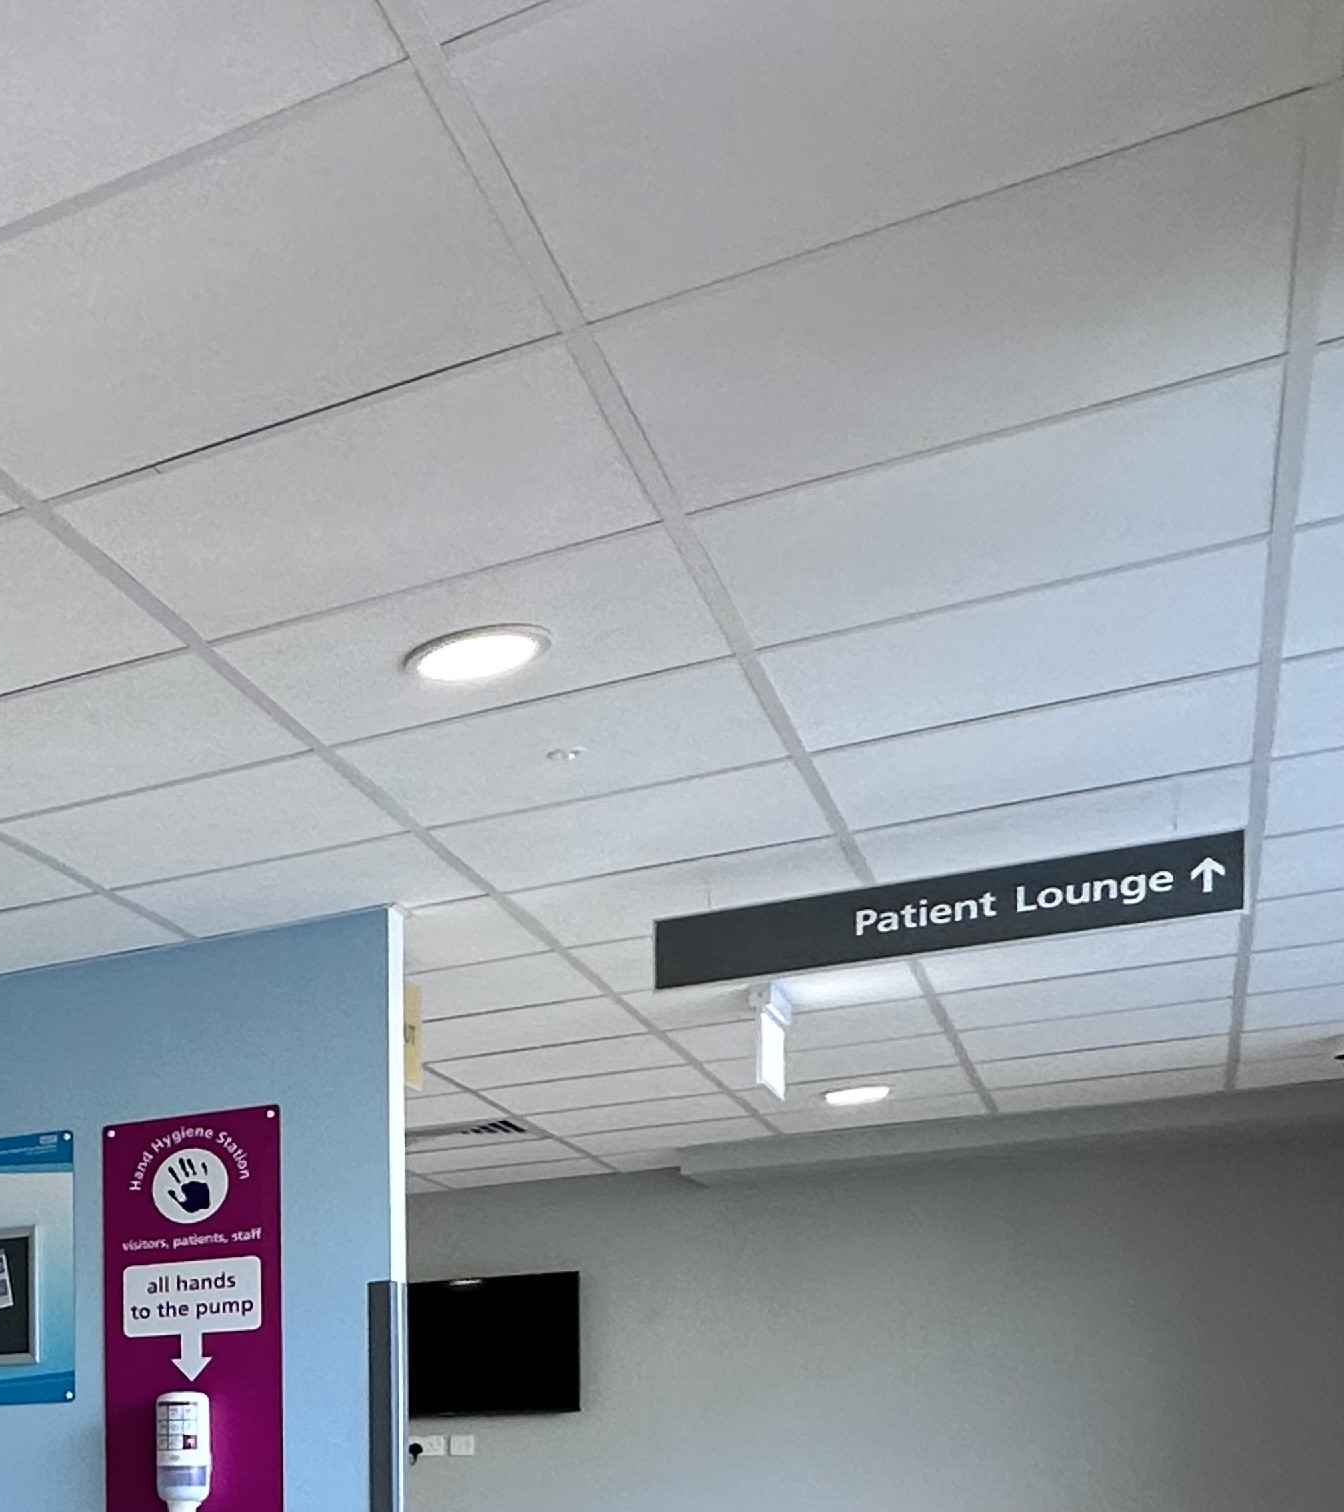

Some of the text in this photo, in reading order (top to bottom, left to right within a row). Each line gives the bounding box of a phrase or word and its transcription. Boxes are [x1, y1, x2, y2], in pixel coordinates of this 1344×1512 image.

[854, 867, 1174, 936] Patient Lounge
[128, 1126, 250, 1191] Hand Hygiene Station
[122, 1227, 262, 1251] visitors, patients, staff
[146, 1271, 236, 1294] all hands
[130, 1299, 254, 1320] to the pump
